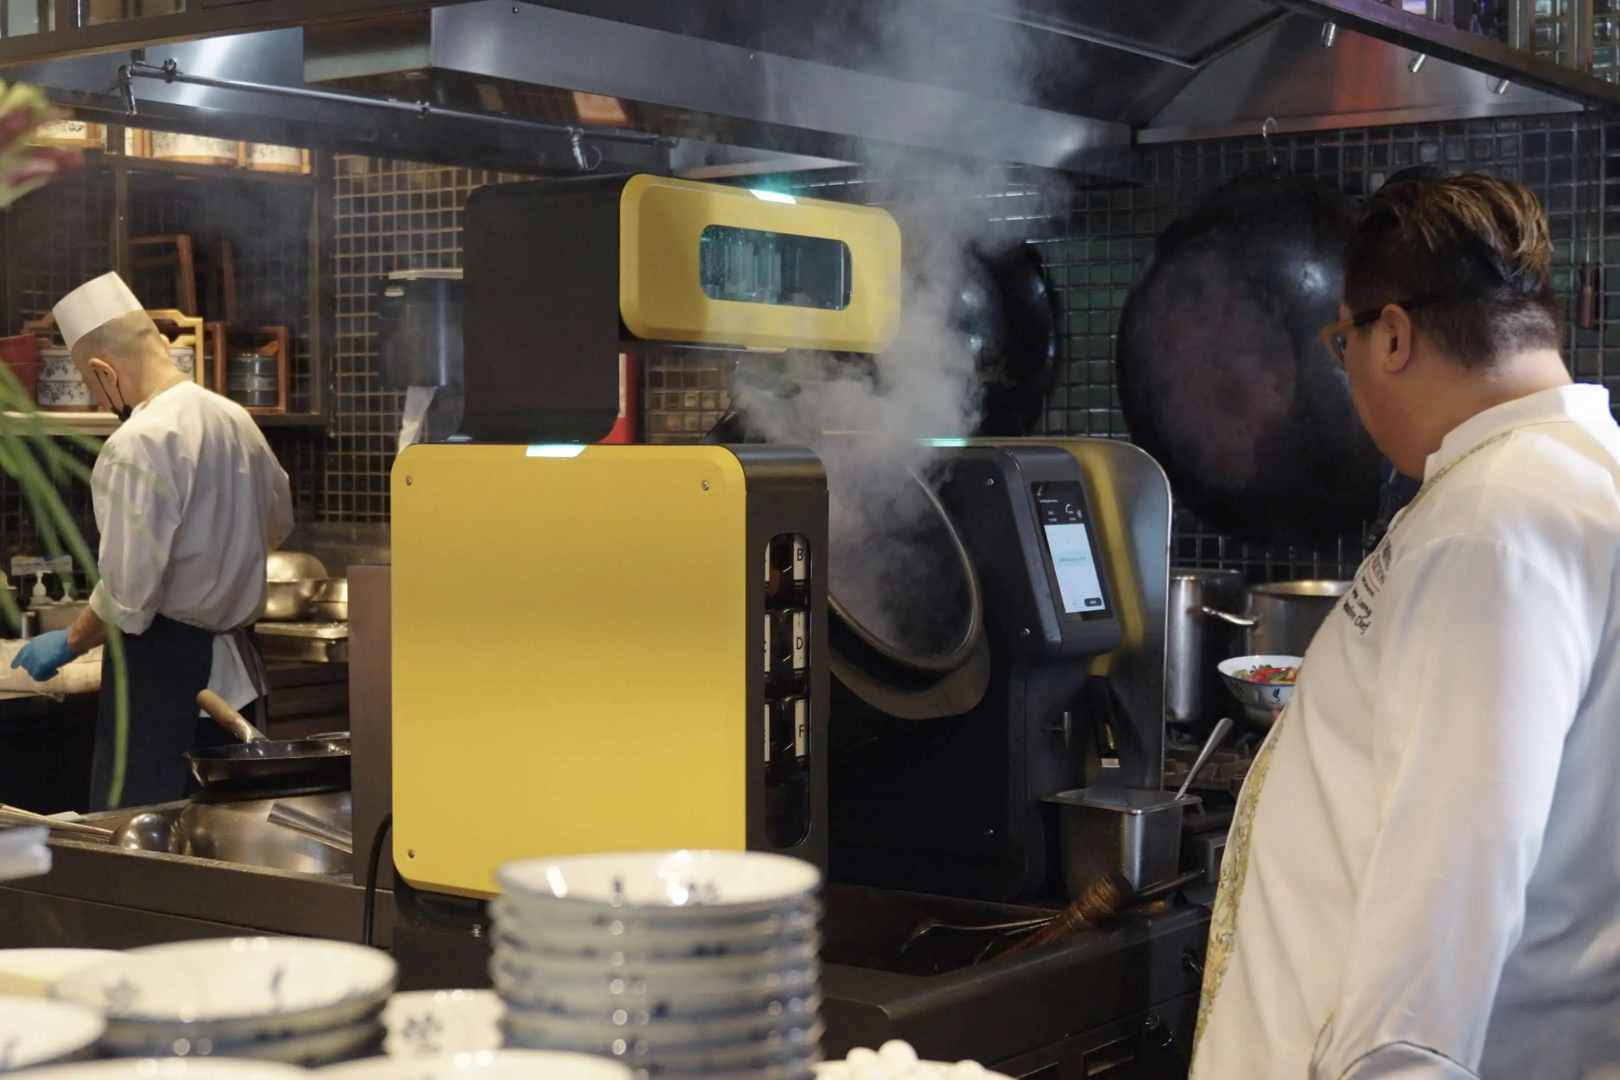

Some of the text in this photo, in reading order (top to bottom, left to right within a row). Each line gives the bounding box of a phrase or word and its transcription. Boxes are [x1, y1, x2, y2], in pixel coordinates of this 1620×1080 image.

[797, 548, 804, 561] B
[796, 636, 804, 650] D
[799, 725, 805, 738] F
